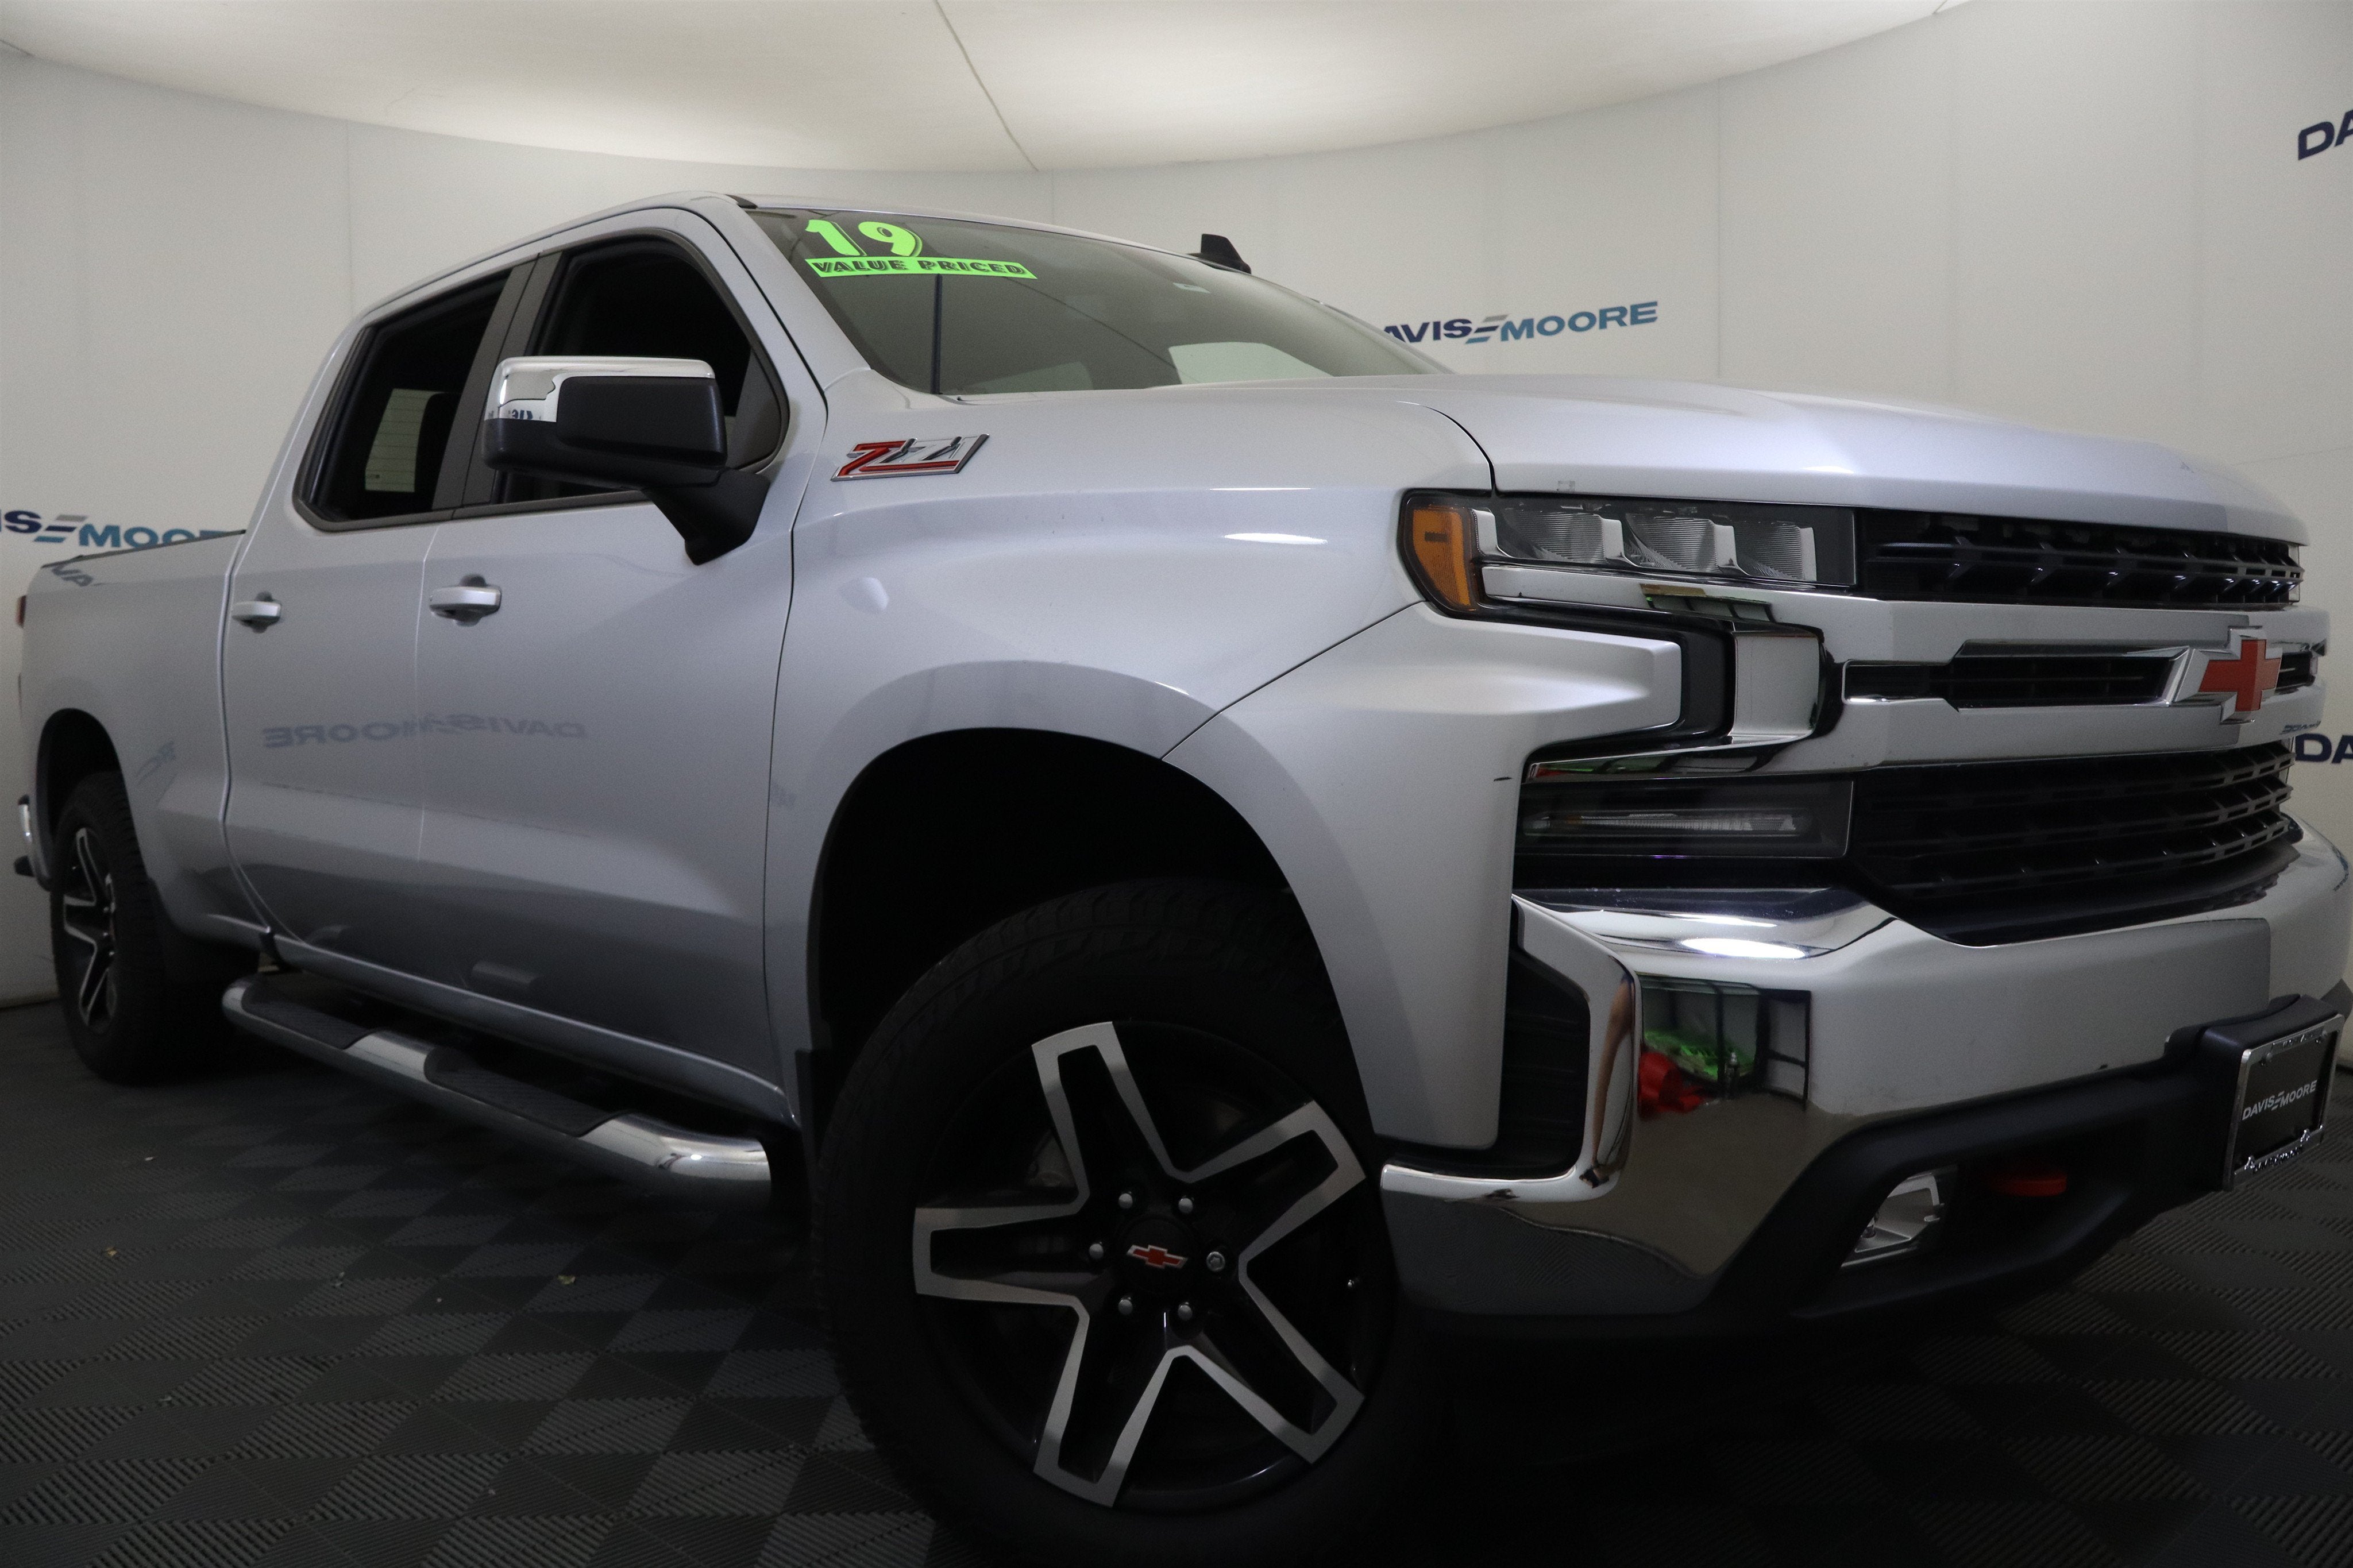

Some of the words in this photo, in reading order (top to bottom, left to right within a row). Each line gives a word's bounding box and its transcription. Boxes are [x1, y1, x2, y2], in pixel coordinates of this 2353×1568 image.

[805, 219, 923, 257] 19
[812, 260, 908, 273] VALUE
[917, 260, 1026, 275] PRICED
[1500, 302, 1658, 341] MOORE
[2242, 1095, 2275, 1121] DAVIS
[2279, 1080, 2317, 1107] MOORE
